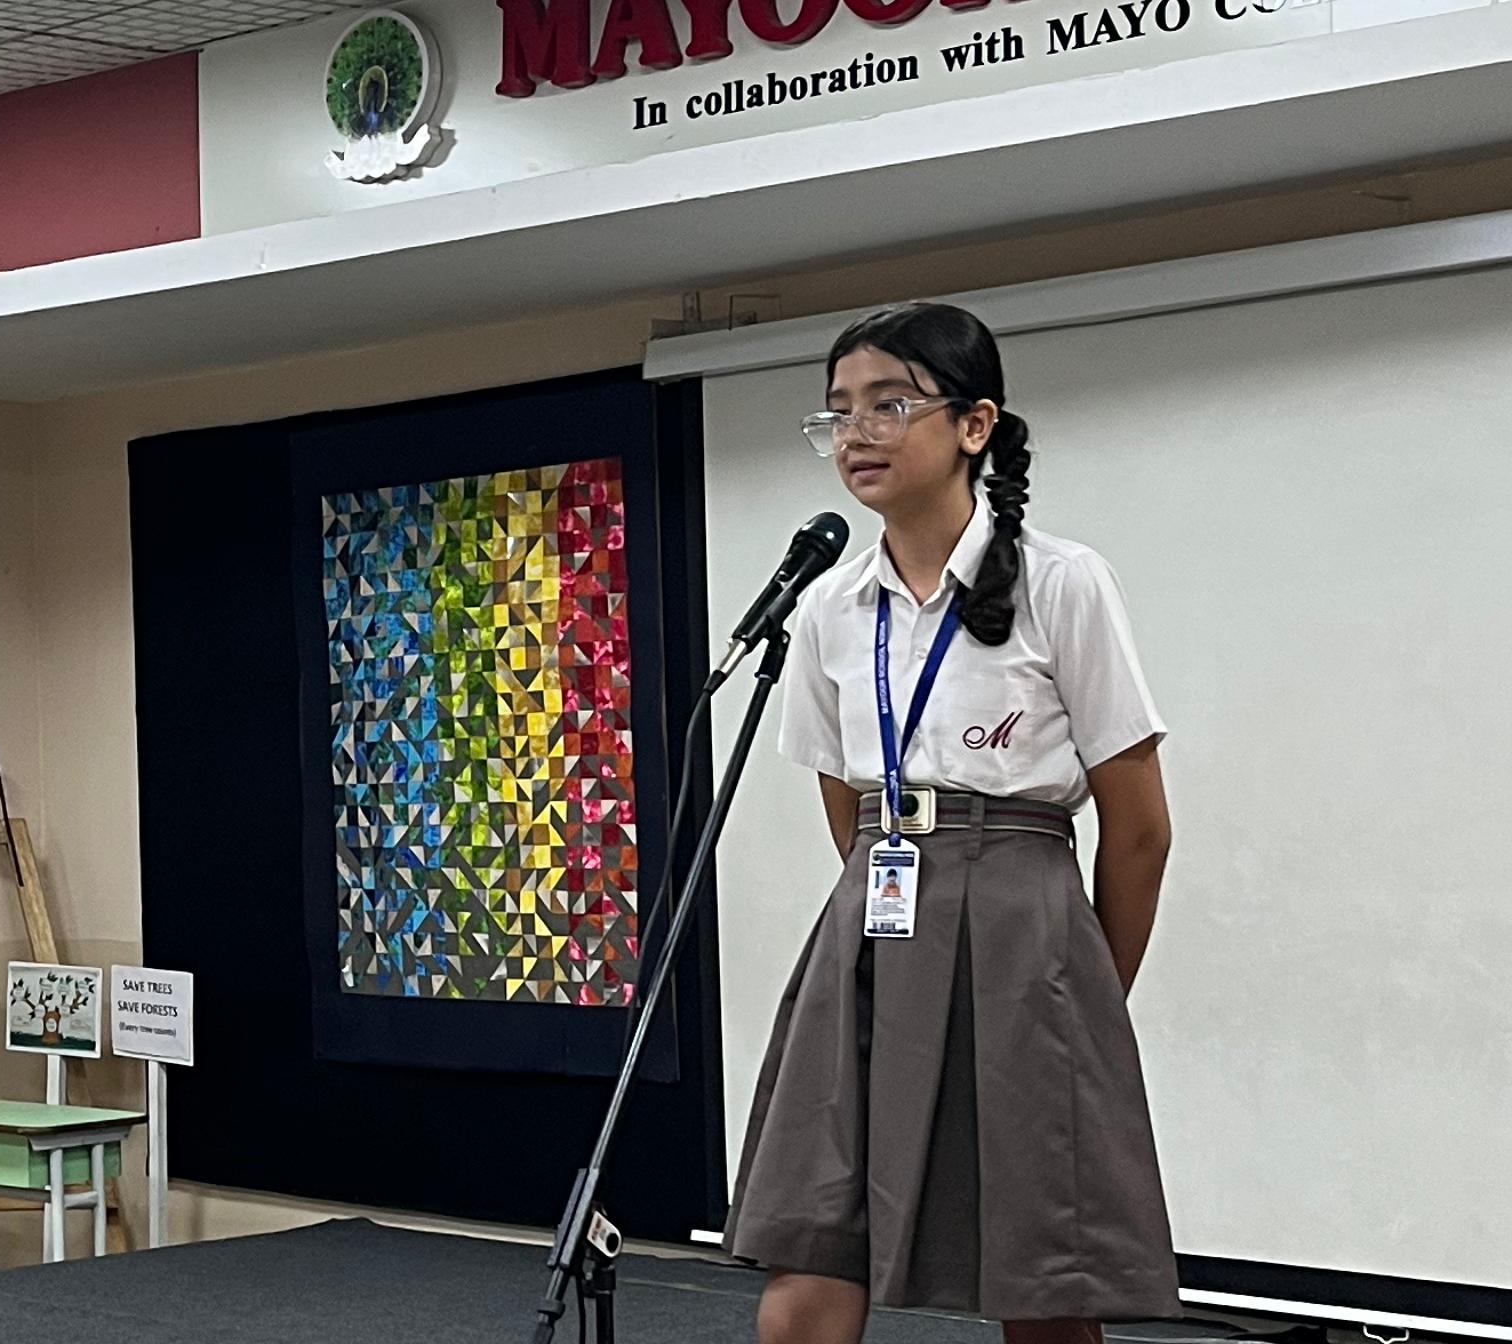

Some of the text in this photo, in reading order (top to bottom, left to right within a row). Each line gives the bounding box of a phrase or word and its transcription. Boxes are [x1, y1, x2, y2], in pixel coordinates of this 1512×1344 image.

[633, 97, 668, 130] In
[686, 52, 919, 119] collaboration
[940, 27, 1025, 72] with
[122, 979, 173, 995] SAVE TREES
[117, 1000, 178, 1017] SAVE FORESTS
